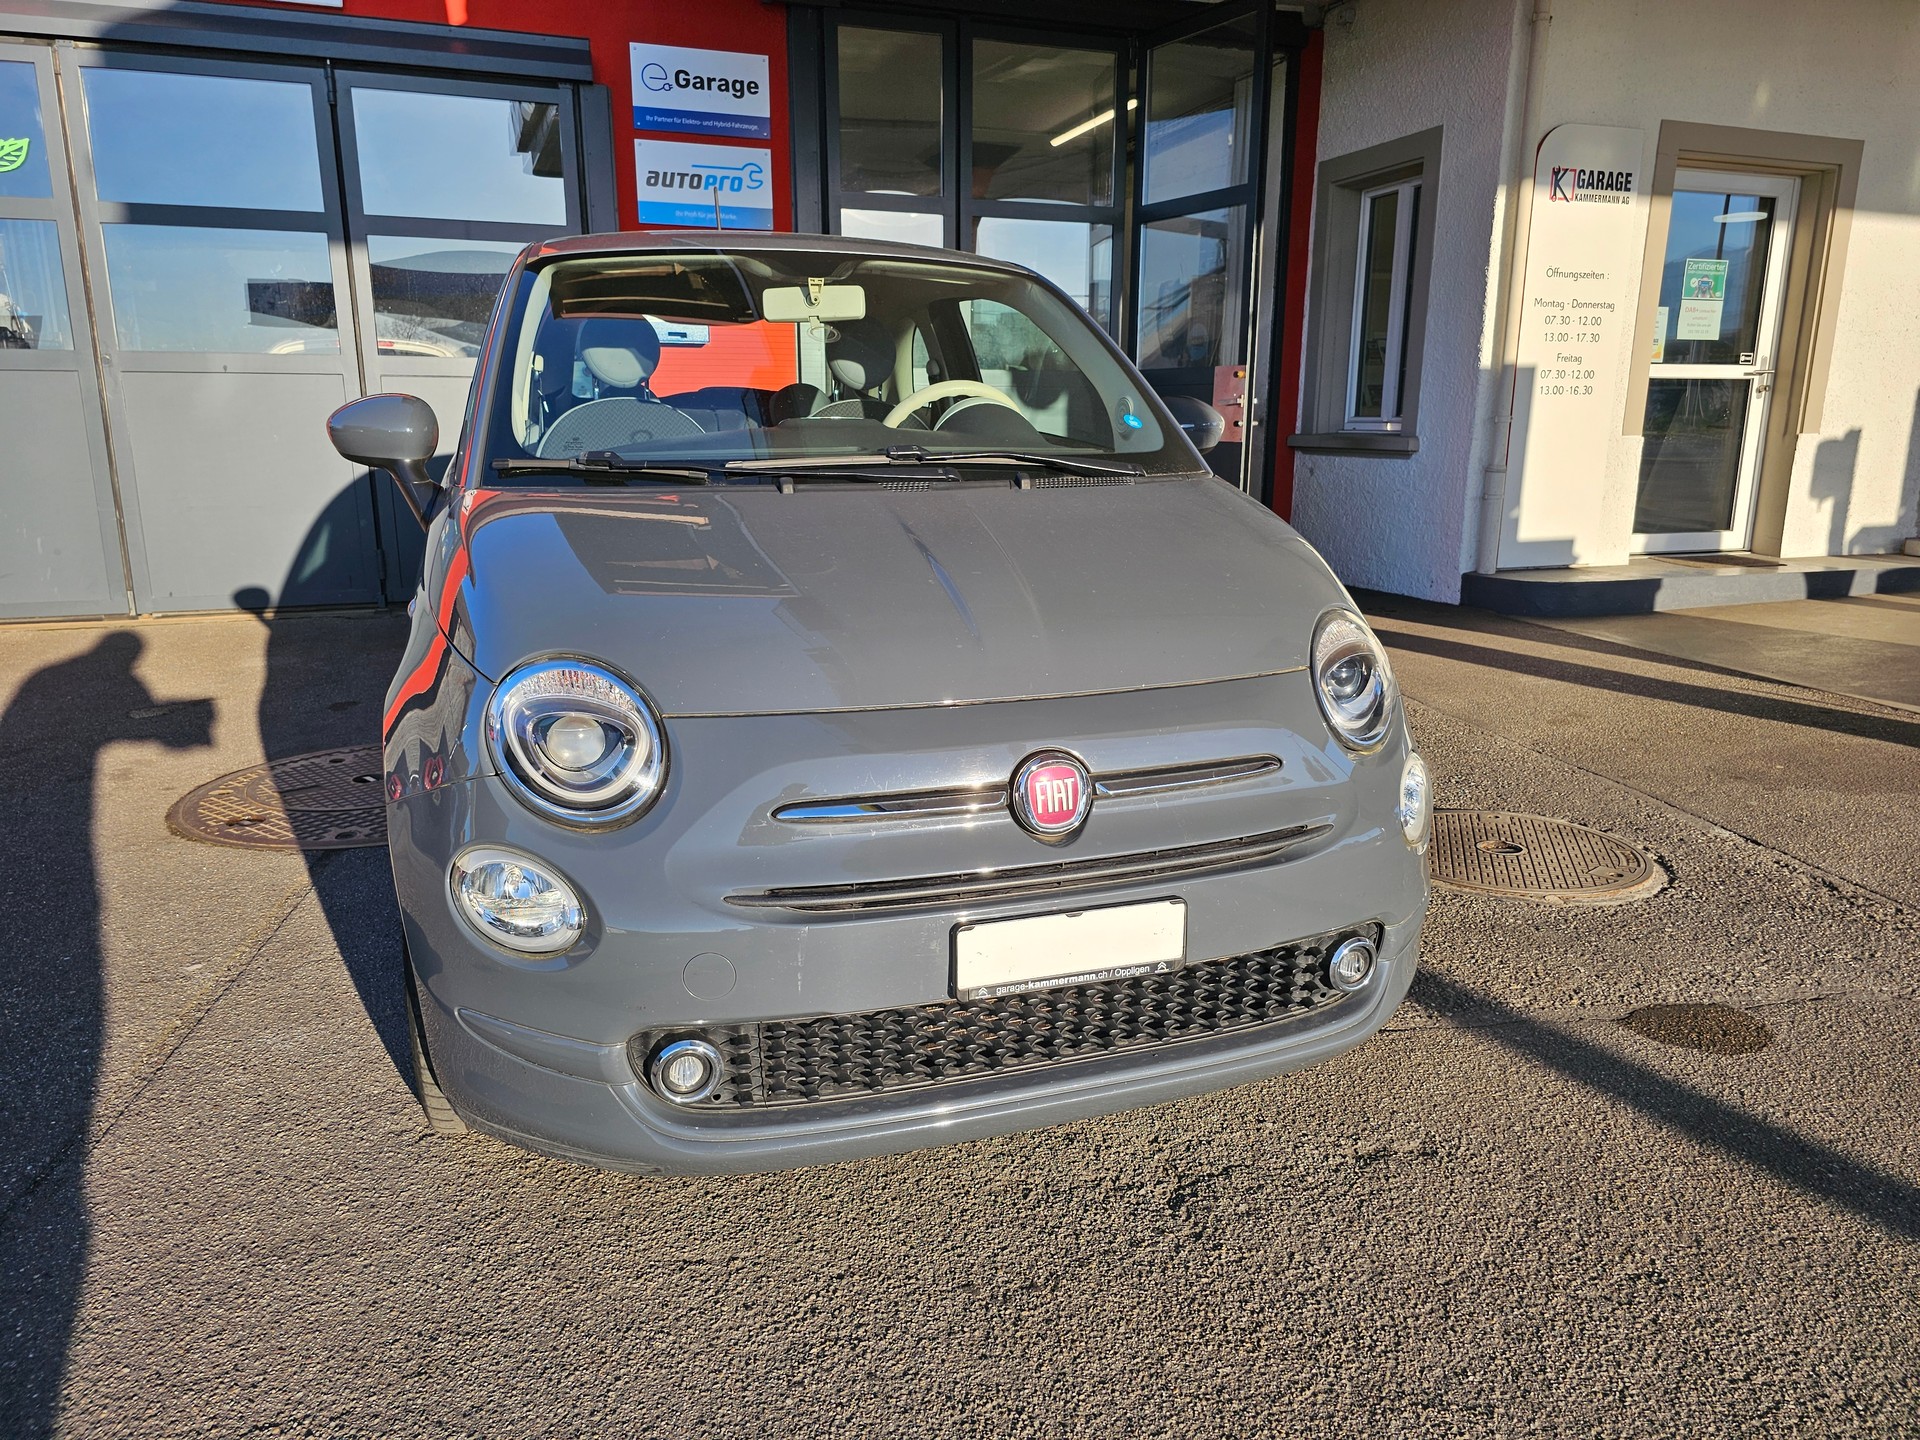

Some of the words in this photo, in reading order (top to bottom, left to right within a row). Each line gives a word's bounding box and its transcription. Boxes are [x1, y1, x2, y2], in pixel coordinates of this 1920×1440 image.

[654, 115, 674, 123] Partner
[674, 116, 682, 124] für
[682, 117, 701, 125] Elektro-
[713, 120, 760, 131] Hybrid-Fahrzeuge.
[1576, 169, 1633, 193] GARAGE
[1574, 192, 1621, 205] KAMMERMANN
[1621, 195, 1631, 205] AG
[1546, 265, 1605, 281] Öffnungszeiten
[1687, 262, 1726, 271] Zertifizierter
[1534, 298, 1565, 310] Montag
[1571, 298, 1616, 312] Donnerstag
[1544, 315, 1571, 326] 07.30
[1577, 316, 1602, 327] 12.00
[1543, 332, 1569, 343] 13.00
[1576, 333, 1600, 344] 17.30
[1556, 352, 1583, 364] Freitag
[1540, 369, 1566, 380] 07.30
[1539, 385, 1565, 396] 13.00
[1034, 777, 1075, 814] FIAT
[995, 969, 1108, 997] garage-kammermann.ch
[1114, 964, 1151, 980] Oppligen
